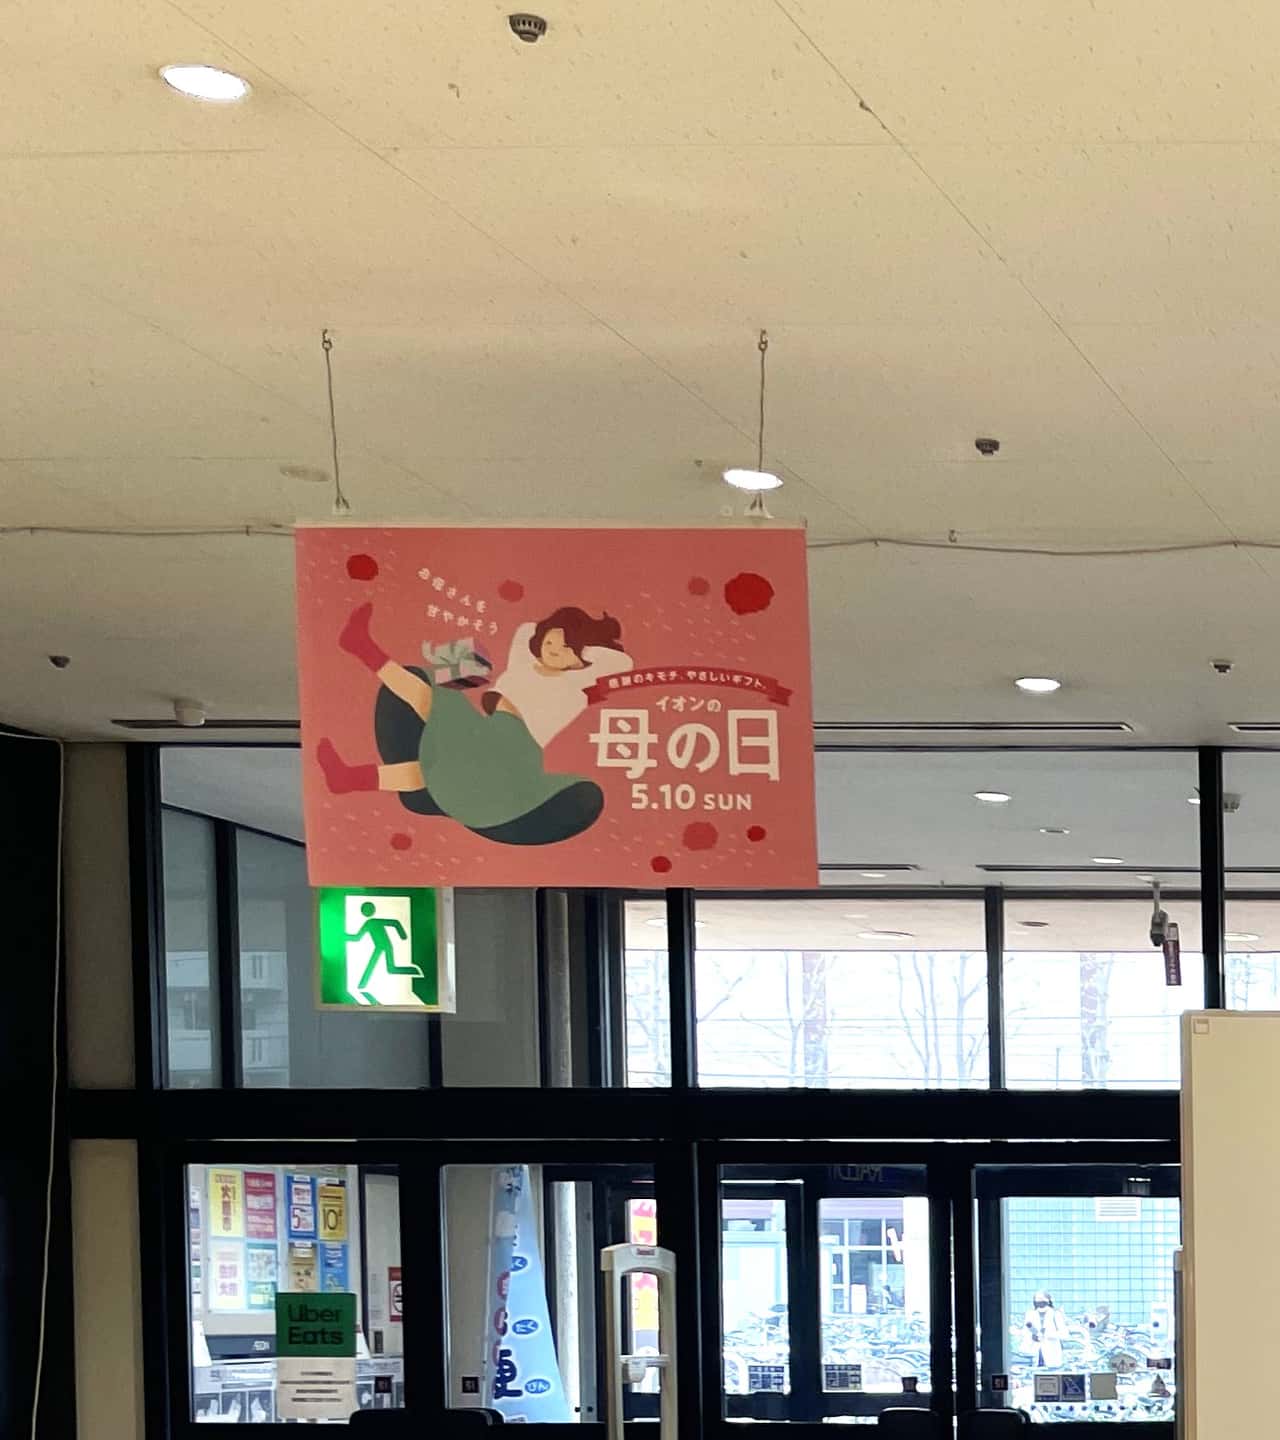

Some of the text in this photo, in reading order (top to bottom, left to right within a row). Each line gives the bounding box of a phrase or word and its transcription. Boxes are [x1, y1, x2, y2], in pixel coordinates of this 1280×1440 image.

[418, 567, 487, 613] お母さんを
[426, 603, 498, 636] 甘やかそう
[655, 695, 722, 713] イオンの
[589, 708, 781, 782] 母の日
[631, 783, 753, 811] 5.10 SUN
[288, 1304, 343, 1323] Uber
[288, 1326, 344, 1345] Eats
